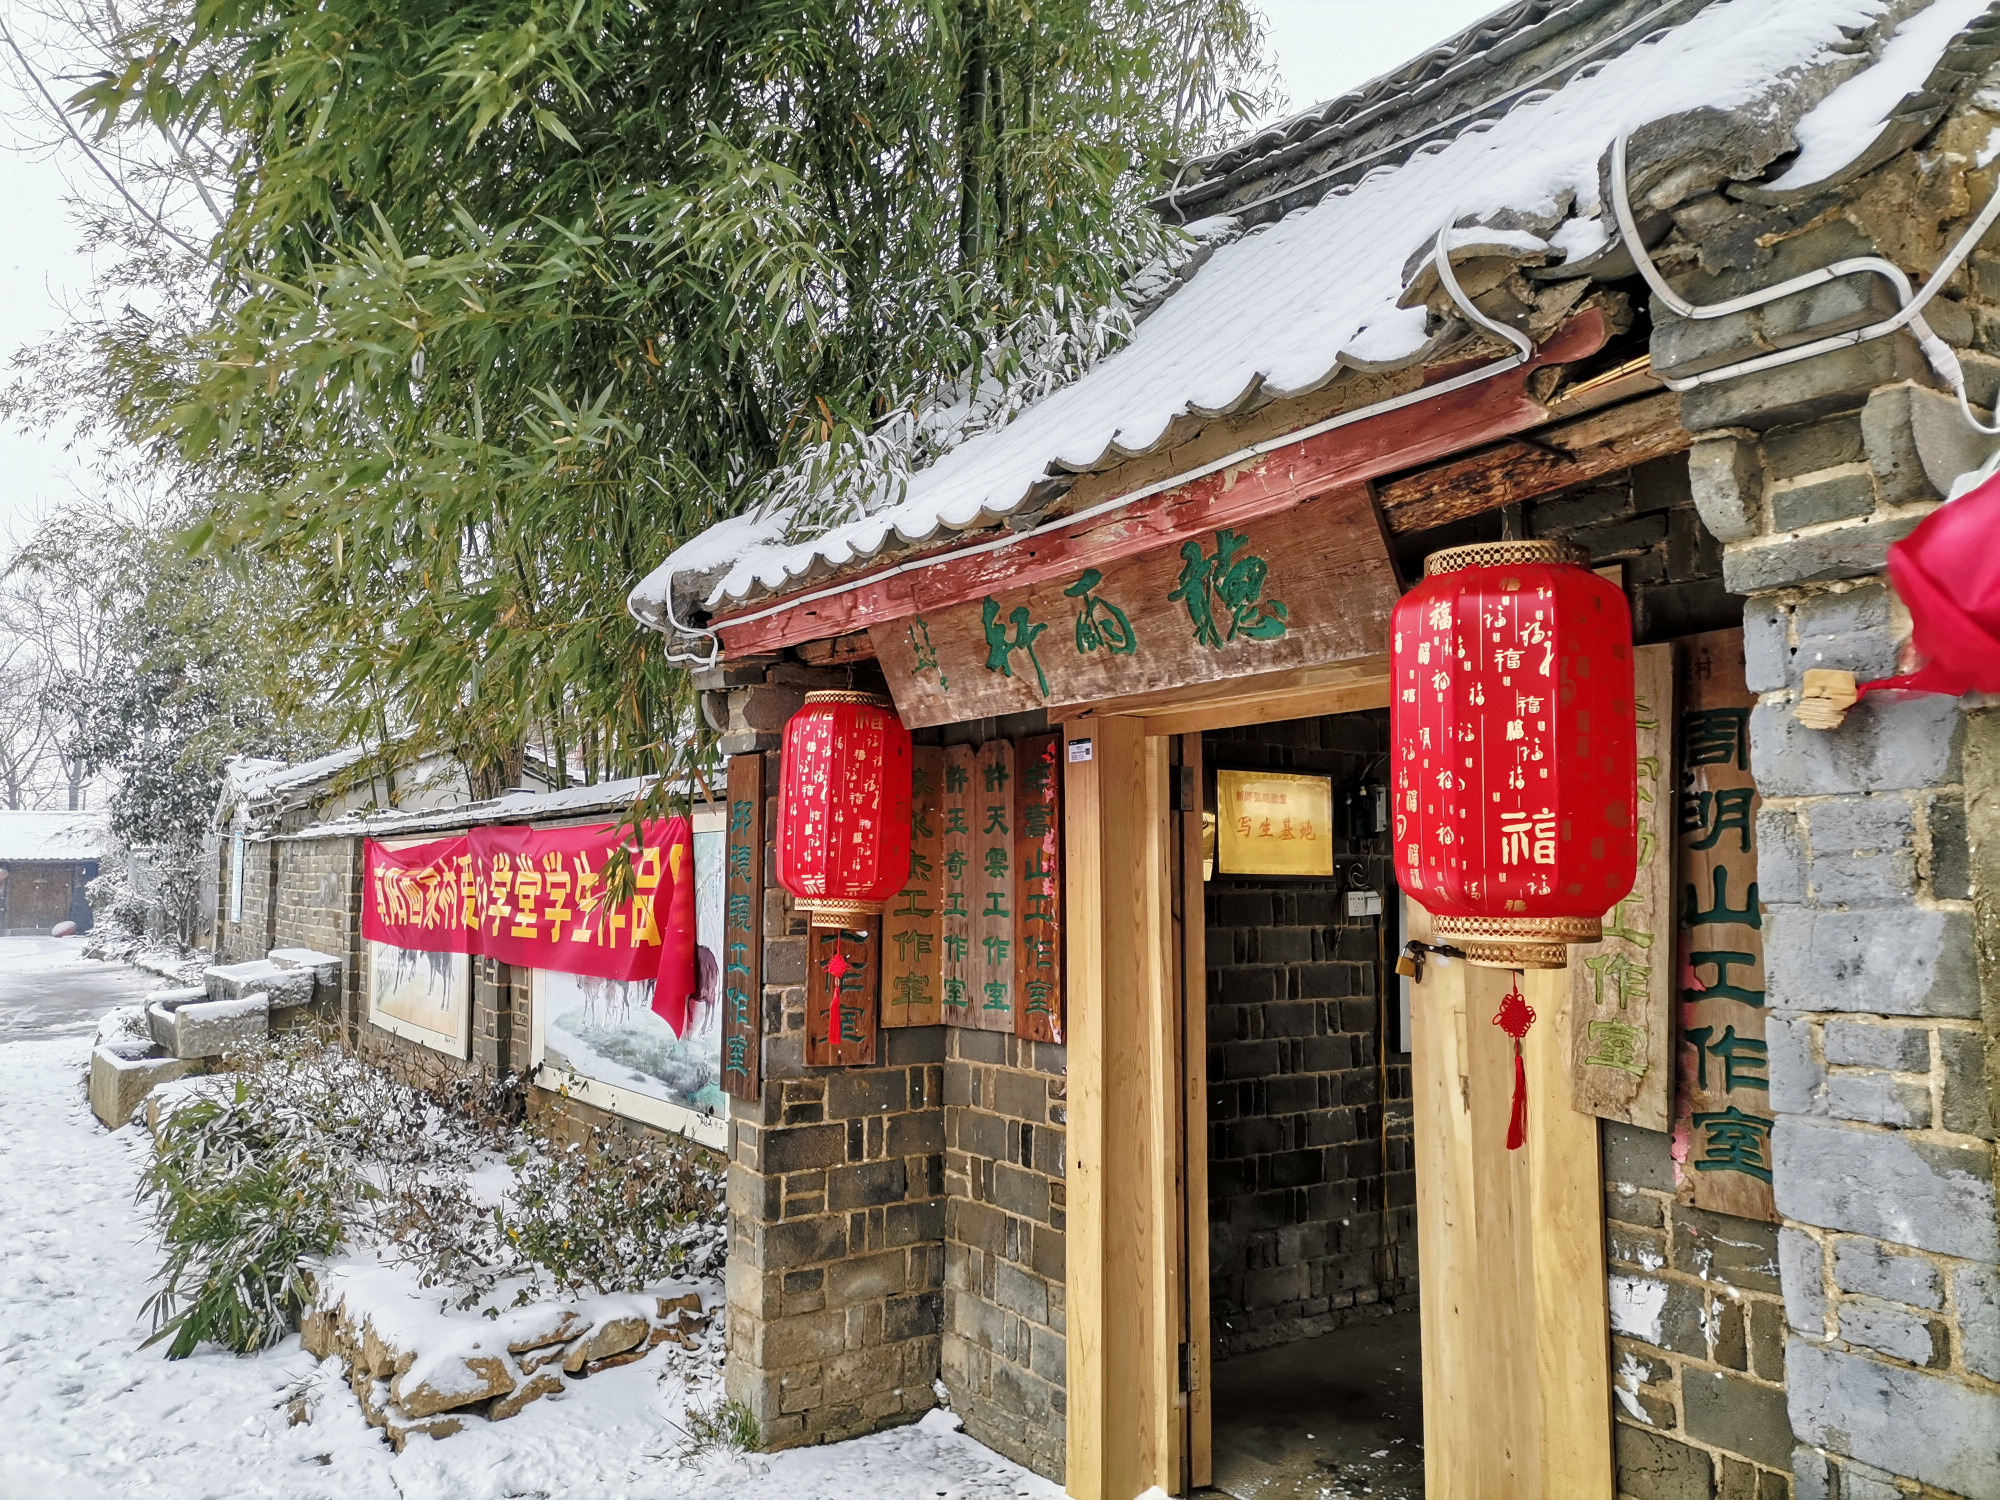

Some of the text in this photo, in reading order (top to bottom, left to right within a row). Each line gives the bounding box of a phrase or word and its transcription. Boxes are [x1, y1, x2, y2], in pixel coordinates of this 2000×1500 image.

[1494, 648, 1525, 673] 福
[1518, 696, 1544, 717] 福
[1236, 815, 1317, 841] 写生基地
